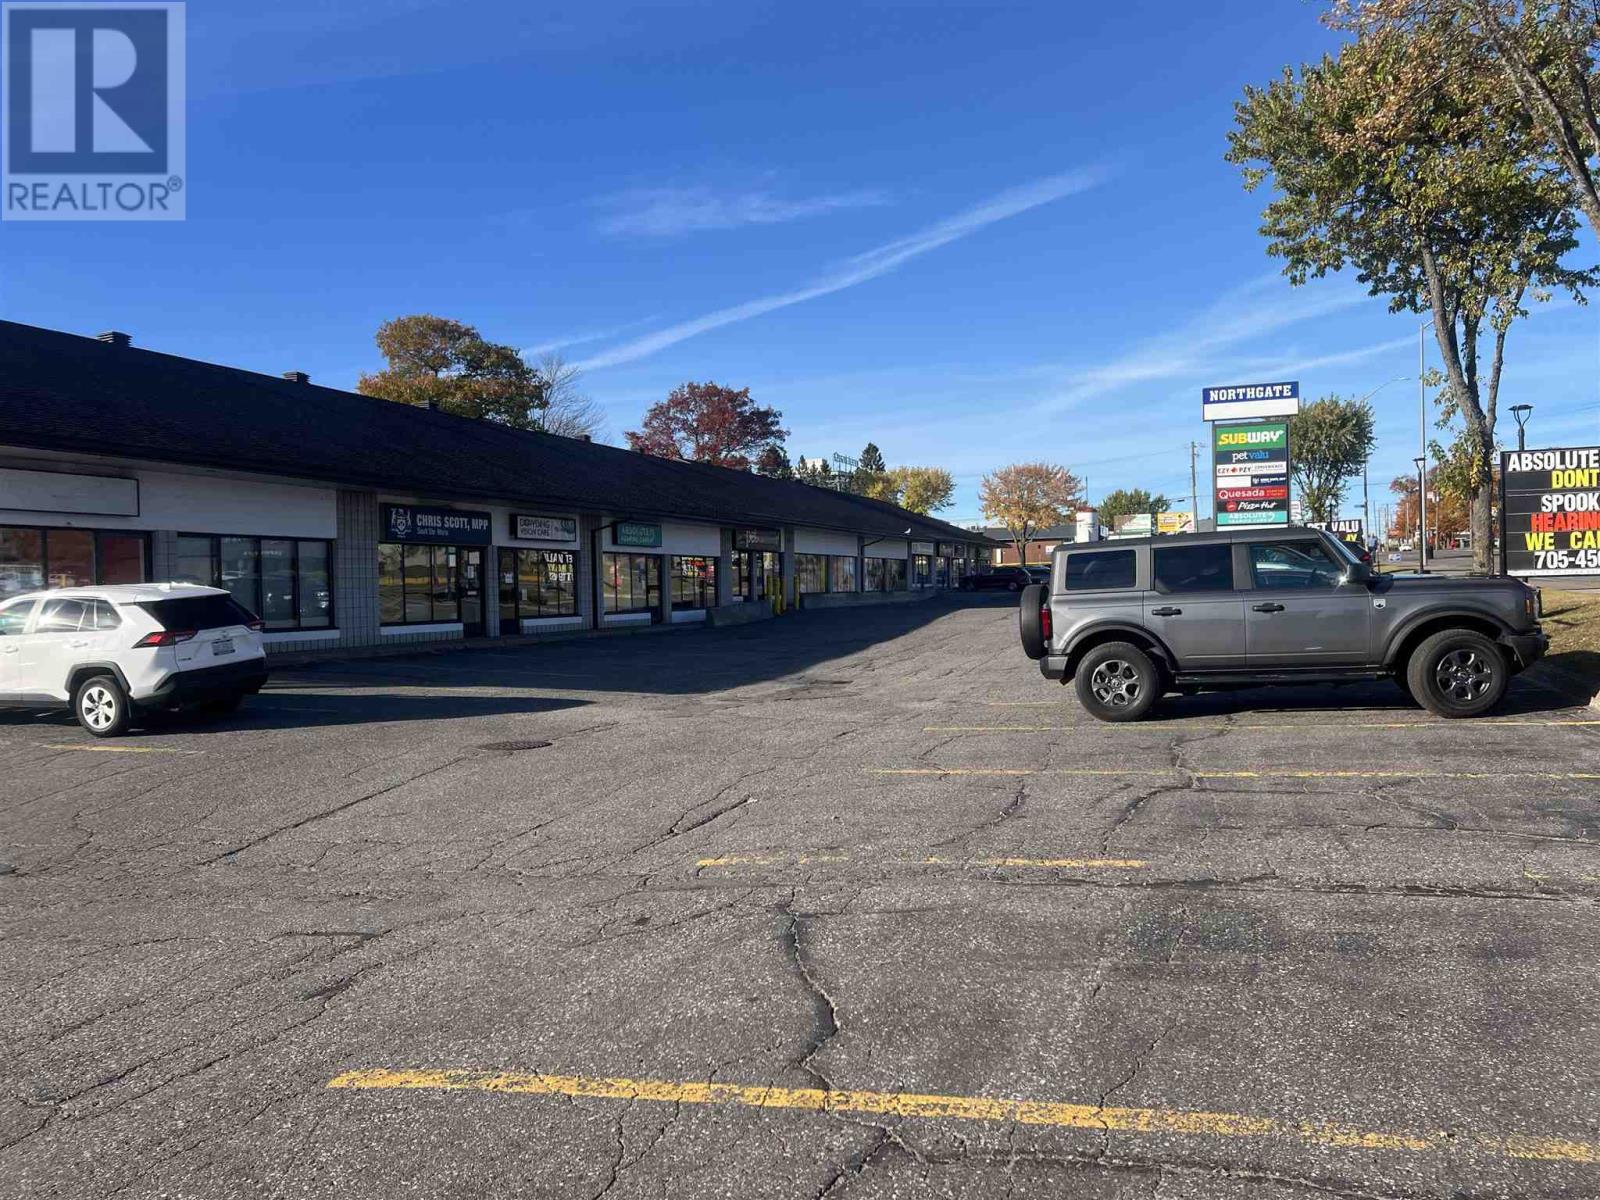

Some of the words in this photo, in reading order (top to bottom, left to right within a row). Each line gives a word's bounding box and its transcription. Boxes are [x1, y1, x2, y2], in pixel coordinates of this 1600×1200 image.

[1209, 385, 1292, 402] NORTHGATE
[1218, 430, 1284, 445] SUBWAY
[1232, 451, 1248, 463] pet
[1249, 450, 1269, 459] valu
[1508, 449, 1599, 472] ABSOLUTE
[1551, 469, 1599, 489] DONT
[1219, 489, 1265, 500] Quesada
[1541, 493, 1600, 513] SPOOK
[1238, 501, 1259, 511] Pizza
[1260, 501, 1278, 510] Hut
[416, 514, 442, 528] CHRIS
[444, 516, 470, 532] SCOTT,
[471, 518, 489, 530] MPP
[1331, 520, 1359, 532] VALU
[1525, 532, 1555, 551] WE
[1569, 530, 1600, 549] CA
